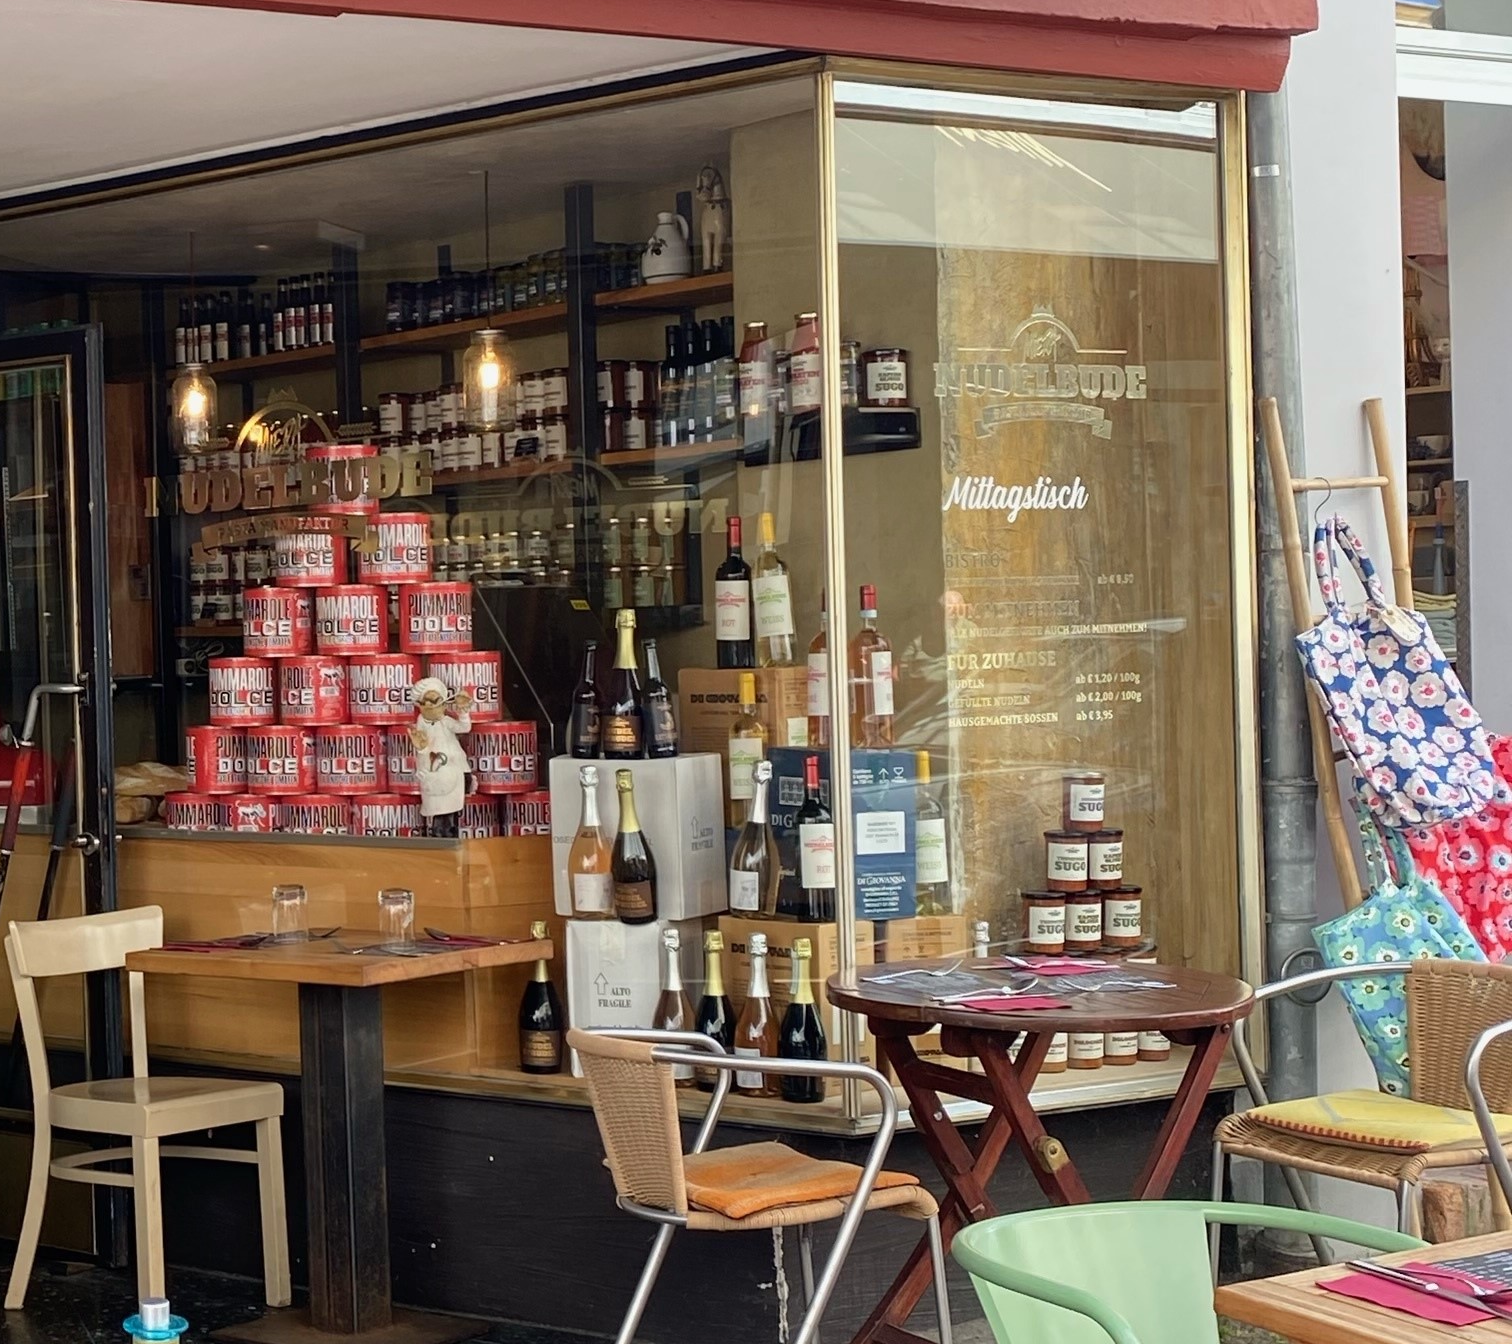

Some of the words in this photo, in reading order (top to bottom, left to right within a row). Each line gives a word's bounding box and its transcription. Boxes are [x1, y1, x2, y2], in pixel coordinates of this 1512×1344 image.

[933, 362, 1147, 400] NUDELBUDE
[144, 452, 433, 517] NUDELBUDE
[942, 475, 1088, 523] Mittagstisch
[1044, 625, 1069, 636] AUCH
[1071, 624, 1090, 634] ZUM
[982, 651, 1056, 669] ZUHAUSE
[1076, 674, 1085, 684] ab
[1095, 674, 1113, 684] 1,20
[1119, 672, 1141, 685] 100g
[1076, 692, 1086, 703] ab
[1095, 693, 1114, 704] 2,00
[1121, 691, 1142, 704] 100g
[949, 714, 1024, 728] HAUSGEMACHTE
[1025, 712, 1058, 725] SOSSEN
[1076, 710, 1087, 721] ab
[1095, 710, 1113, 721] 3,95
[610, 988, 631, 997] ALTO
[598, 998, 632, 1008] FRAGILE
